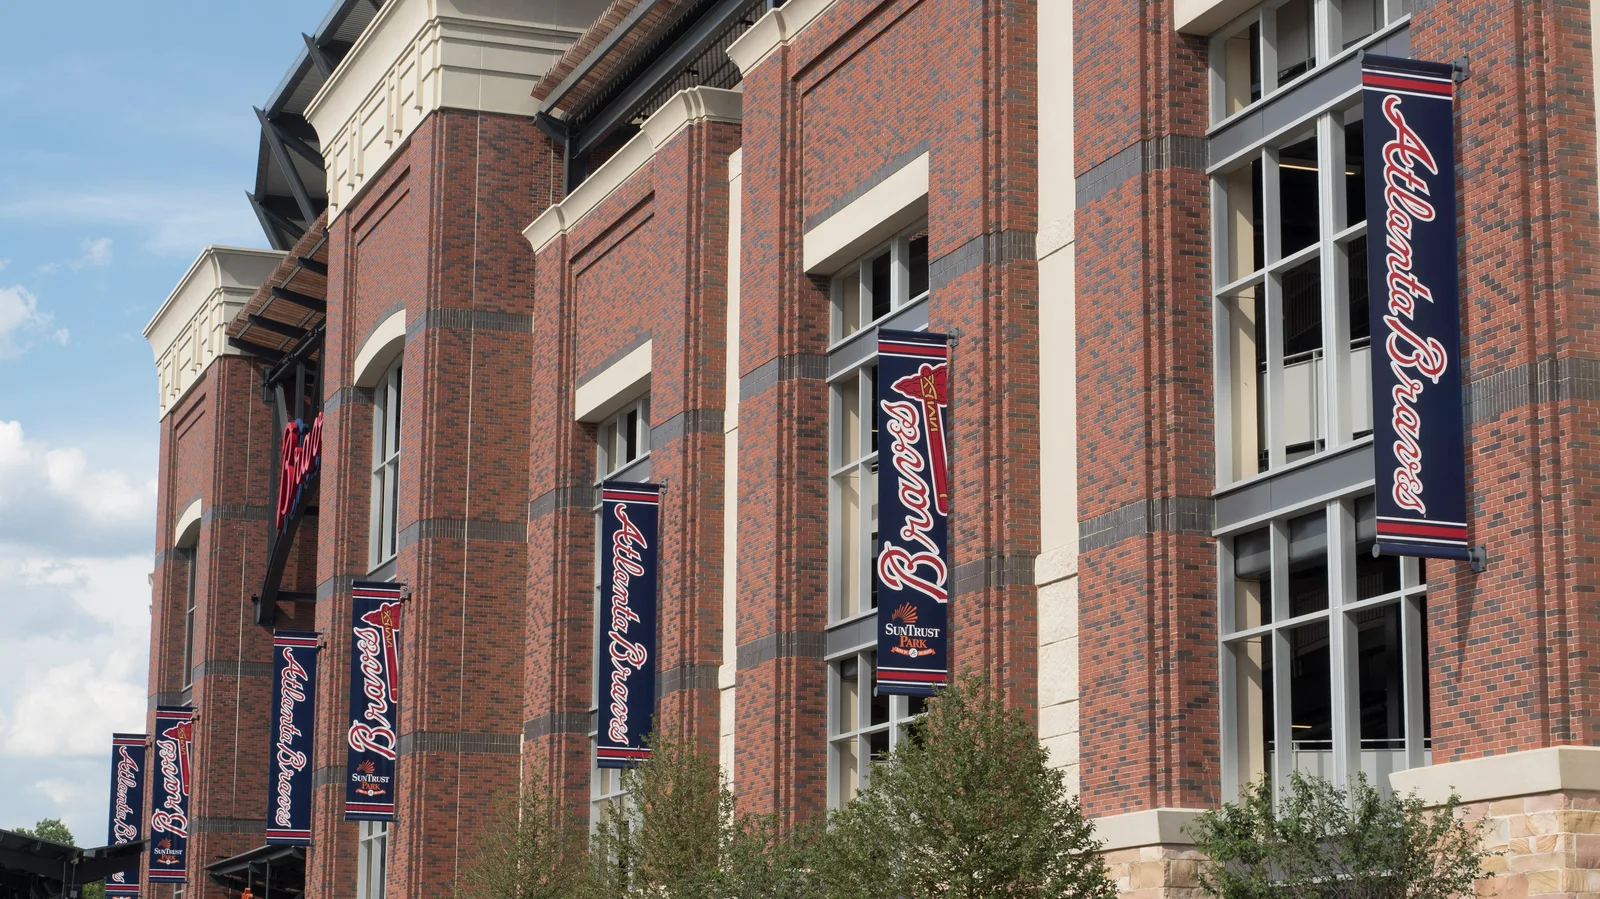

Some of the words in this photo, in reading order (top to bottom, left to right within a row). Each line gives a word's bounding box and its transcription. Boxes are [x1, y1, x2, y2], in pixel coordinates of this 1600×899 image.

[1382, 94, 1438, 321] Atlanta
[1383, 315, 1448, 515] Braves
[877, 399, 948, 604] Braves
[611, 503, 647, 634] Atlanta
[279, 647, 308, 745] Atlanta
[348, 626, 396, 761] Braves
[608, 630, 648, 745] Braves
[899, 635, 928, 649] PARK
[115, 745, 139, 820] Atlanta
[152, 739, 188, 838] Braves
[275, 742, 307, 829] Braves
